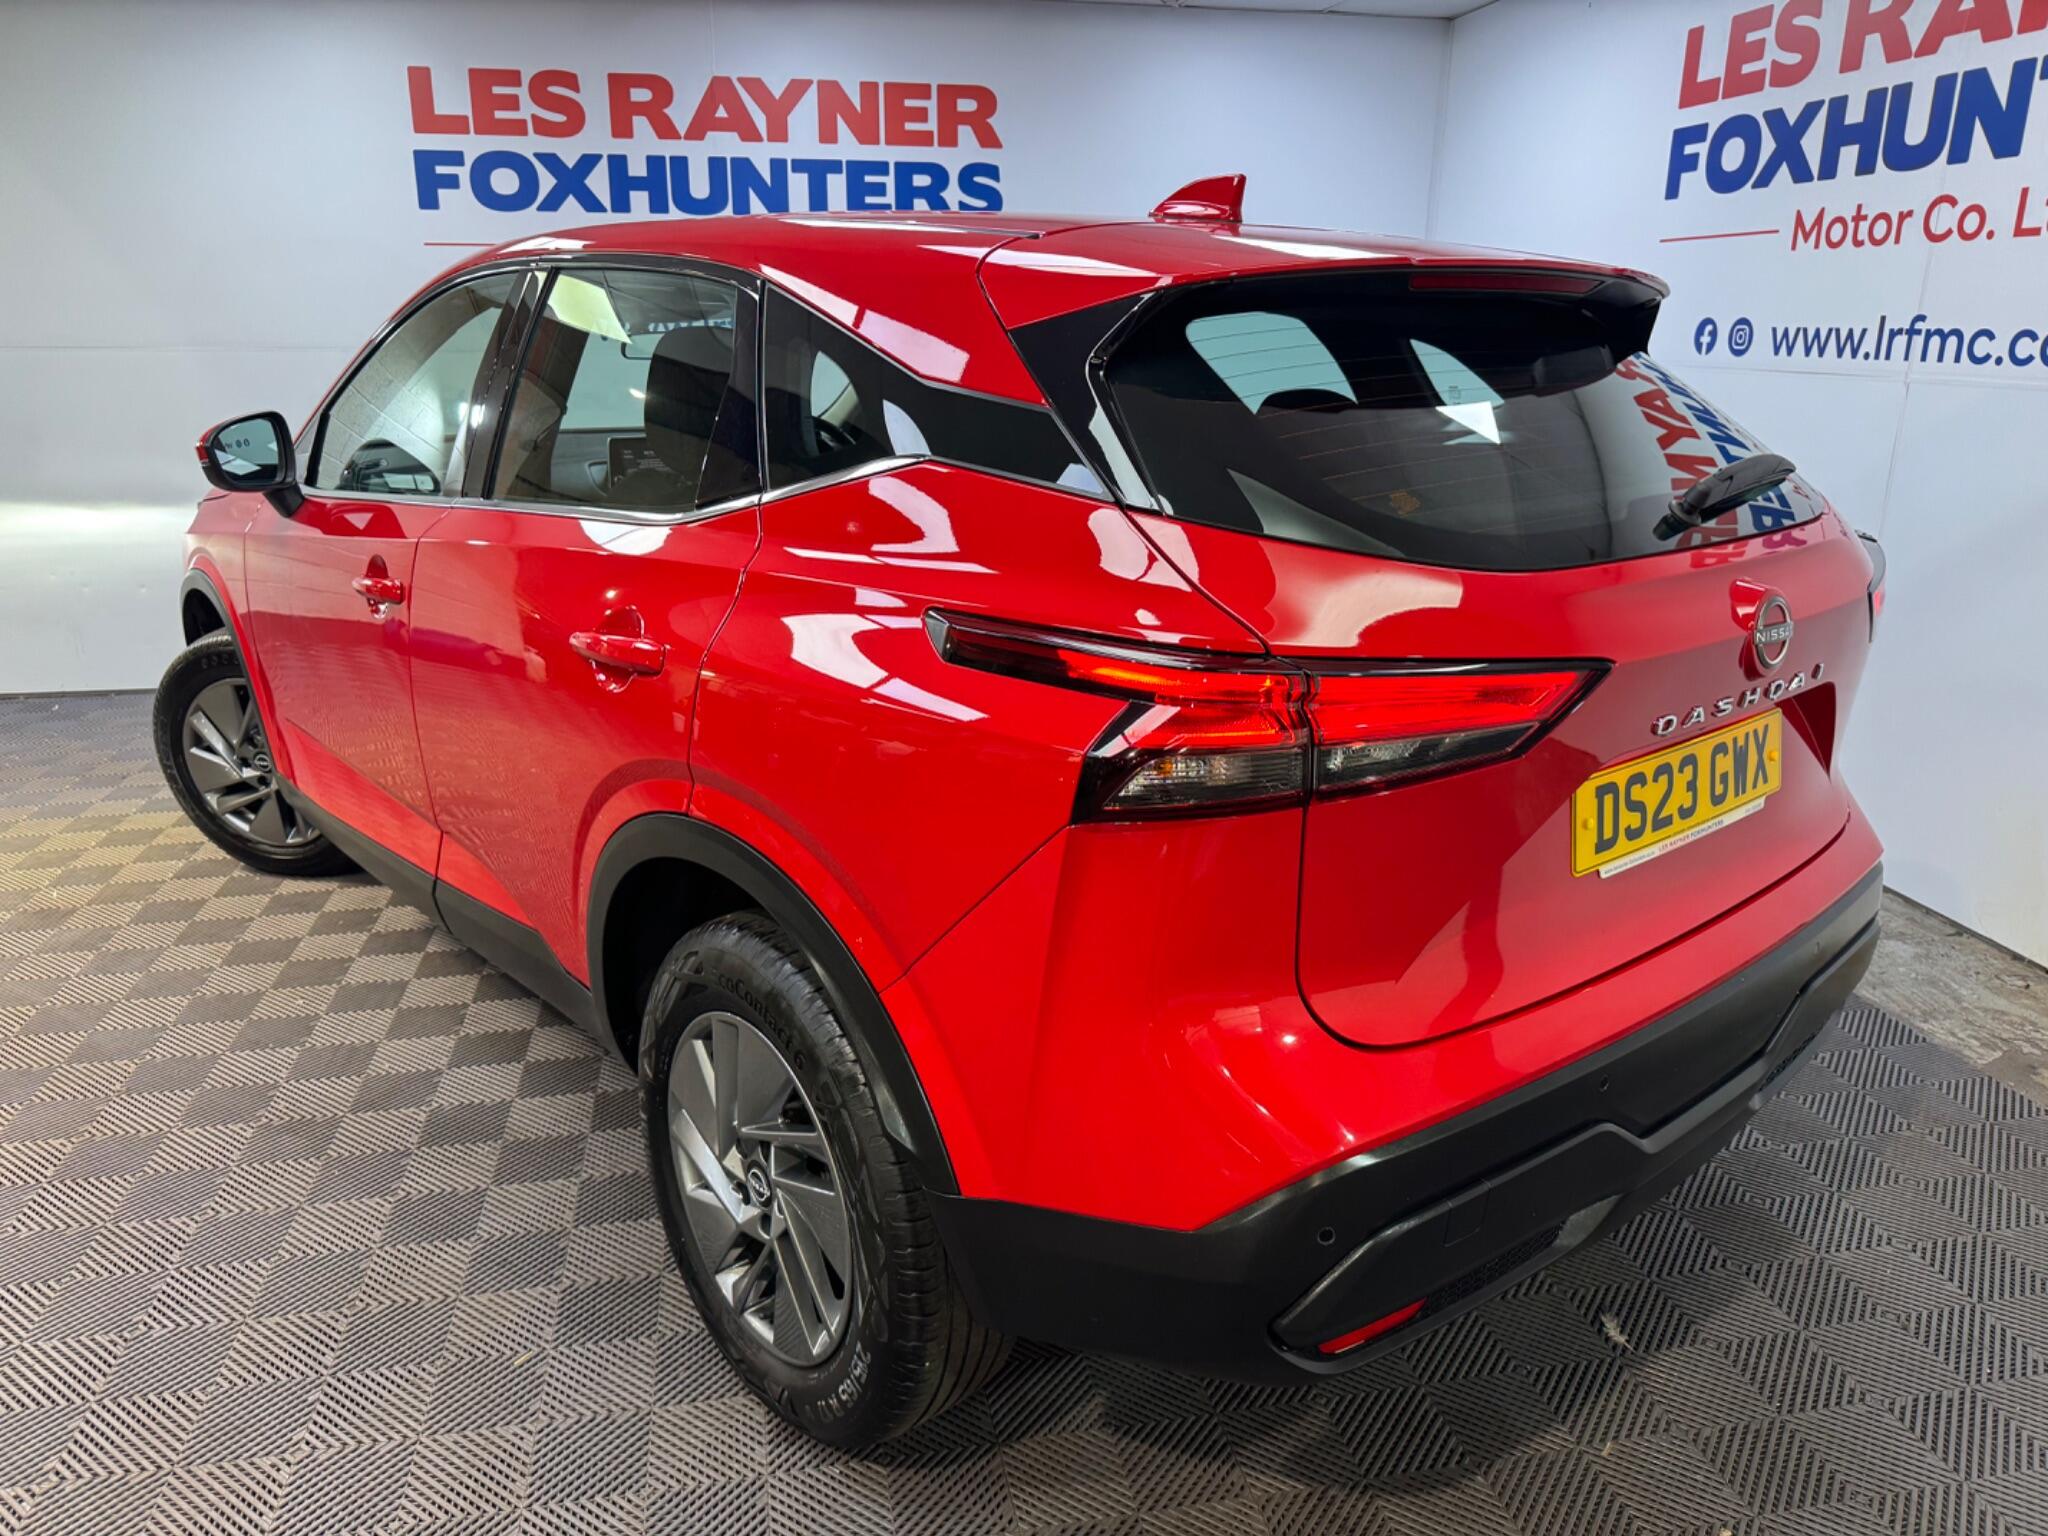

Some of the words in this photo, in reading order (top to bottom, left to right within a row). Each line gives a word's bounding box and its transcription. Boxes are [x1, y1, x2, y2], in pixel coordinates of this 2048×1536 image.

[1678, 0, 1824, 110] LES
[406, 65, 586, 137] LES
[607, 73, 1004, 149] RAYNER
[412, 149, 1004, 214] FOXHUNTERS
[1790, 204, 1914, 251] Motor
[1923, 194, 1995, 244] Co.
[2013, 187, 2048, 238] L
[1595, 753, 1698, 855] DS23
[1709, 723, 1770, 807] GWX
